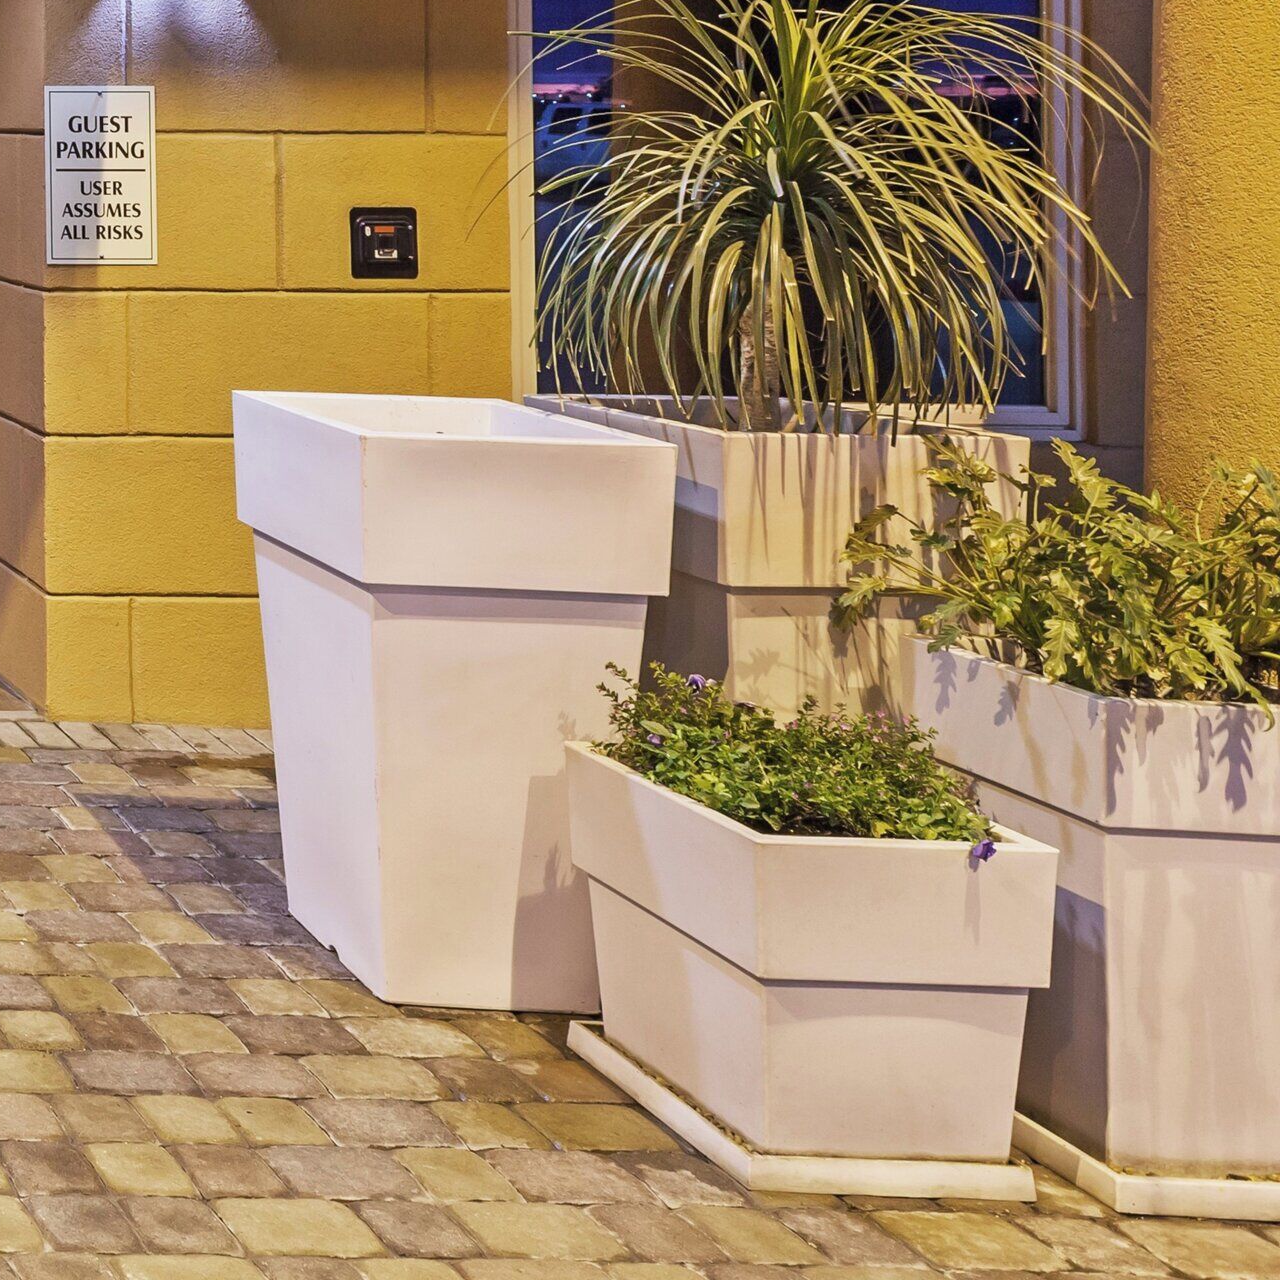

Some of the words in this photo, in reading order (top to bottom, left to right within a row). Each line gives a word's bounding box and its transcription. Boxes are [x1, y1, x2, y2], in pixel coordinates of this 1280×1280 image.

[68, 115, 133, 133] GUEST
[56, 141, 145, 159] PARKING
[80, 180, 123, 196] USER
[62, 203, 142, 218] ASSUMES
[60, 225, 90, 240] ALL
[96, 225, 143, 240] RISKS
